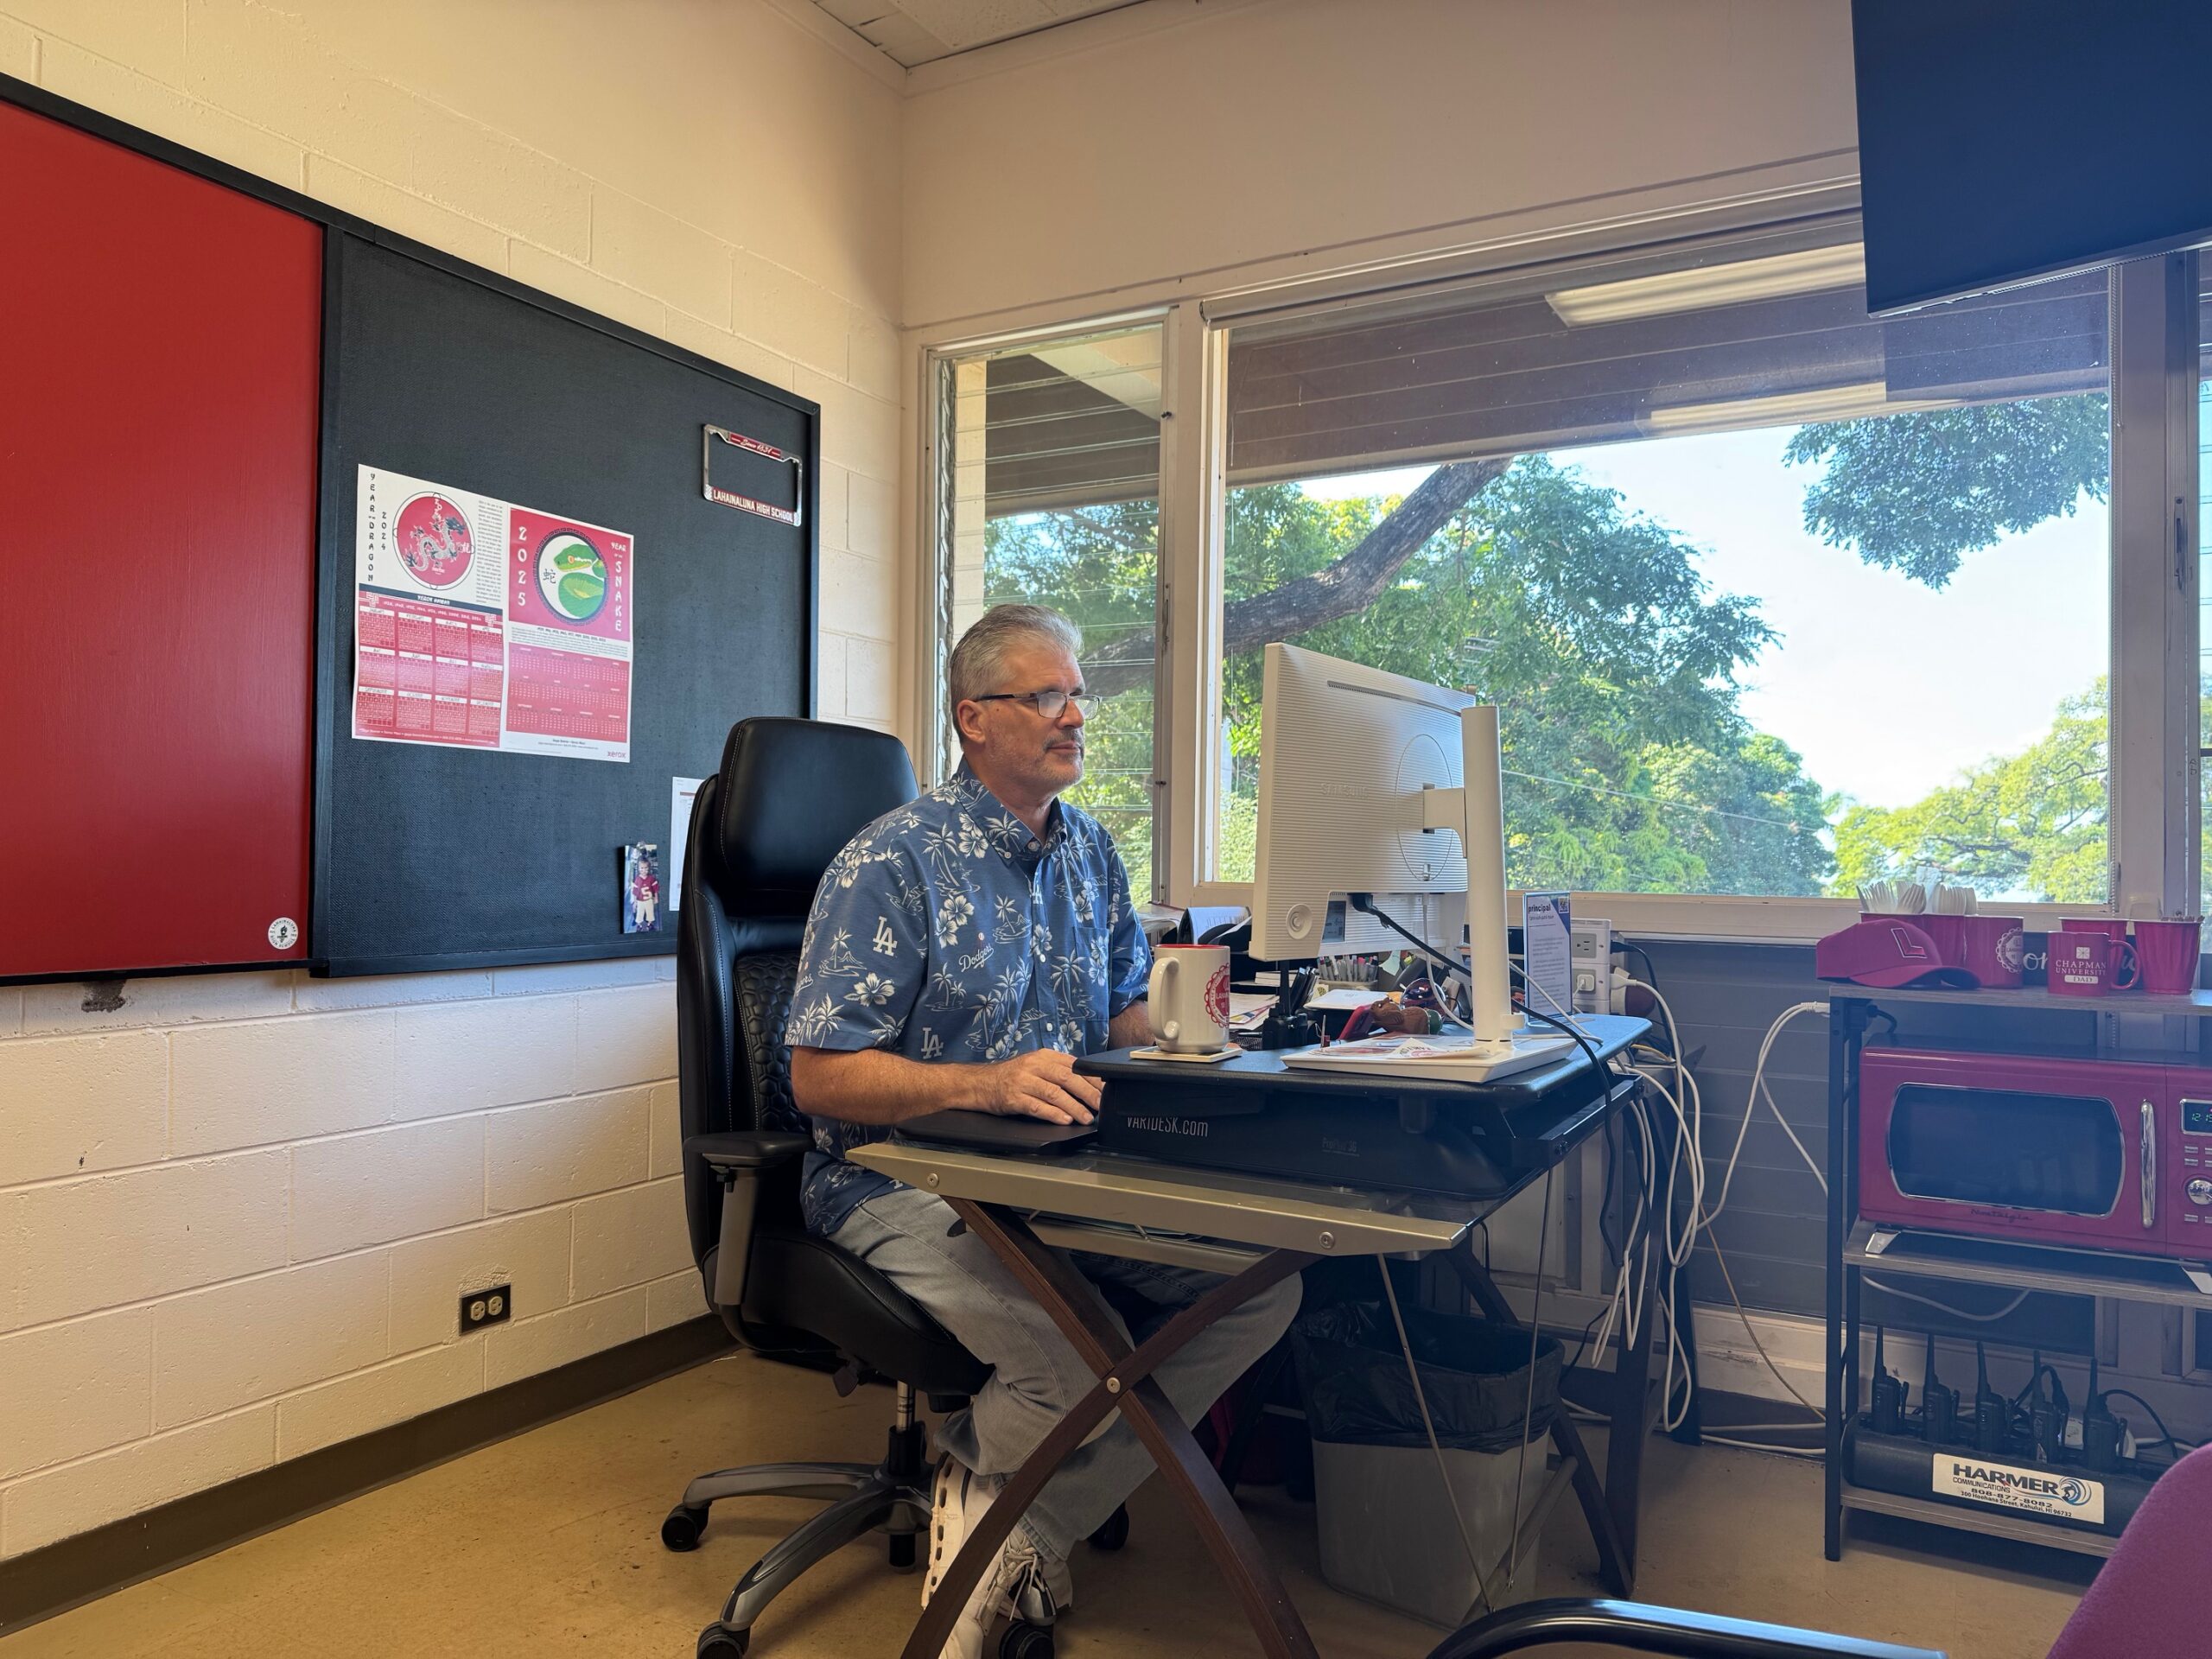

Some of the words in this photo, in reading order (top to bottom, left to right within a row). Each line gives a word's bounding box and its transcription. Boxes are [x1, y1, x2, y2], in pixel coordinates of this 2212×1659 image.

[714, 489, 755, 510] LAHAINALUNA
[756, 503, 770, 515] HIGH
[771, 508, 793, 522] SCHOOL
[611, 542, 626, 551] YEAR
[518, 526, 527, 607] 2025
[641, 887, 652, 900] 5
[1528, 904, 1552, 914] principal
[872, 916, 898, 957] LA
[1891, 927, 1928, 959] L
[958, 943, 994, 973] Dodgers
[2056, 959, 2107, 969] CHAPMAN
[920, 1027, 944, 1059] LA
[1128, 1116, 1209, 1137] VARIDESK.com
[1953, 1463, 2059, 1496] HARMER
[1953, 1476, 2011, 1494] COMMUNICATIONS
[1971, 1488, 2053, 1508] 808-877-8082
[1973, 1492, 1999, 1503] Hoohana
[1999, 1497, 2019, 1507] Street,
[2019, 1501, 2044, 1513] Kahului,
[2053, 1509, 2072, 1517] 96732
